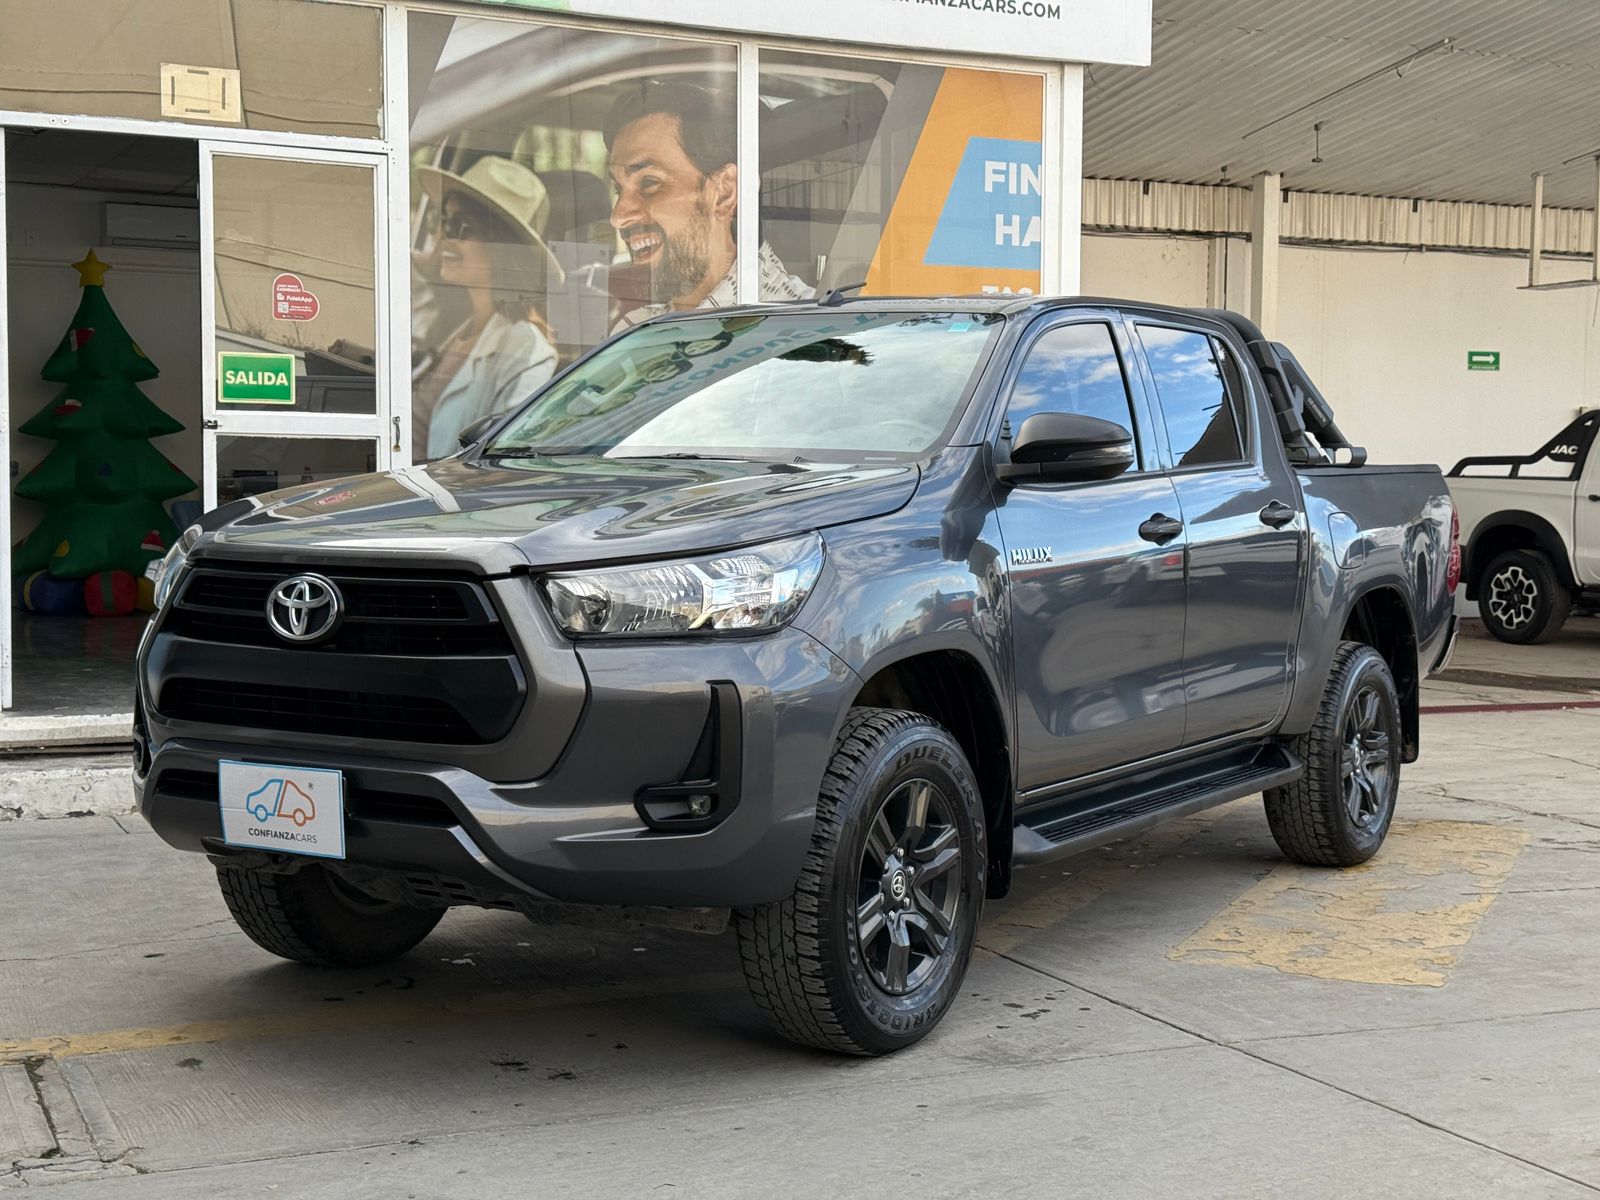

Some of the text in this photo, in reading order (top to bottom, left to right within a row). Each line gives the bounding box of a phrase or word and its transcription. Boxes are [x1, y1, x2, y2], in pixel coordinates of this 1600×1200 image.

[984, 160, 1041, 196] FIN
[995, 213, 1041, 247] HA
[225, 370, 289, 386] SALIDA
[1550, 444, 1579, 455] JAC
[1011, 546, 1053, 564] HILUX
[896, 745, 977, 808] DUELER
[248, 827, 318, 843] CONFIANZACARS
